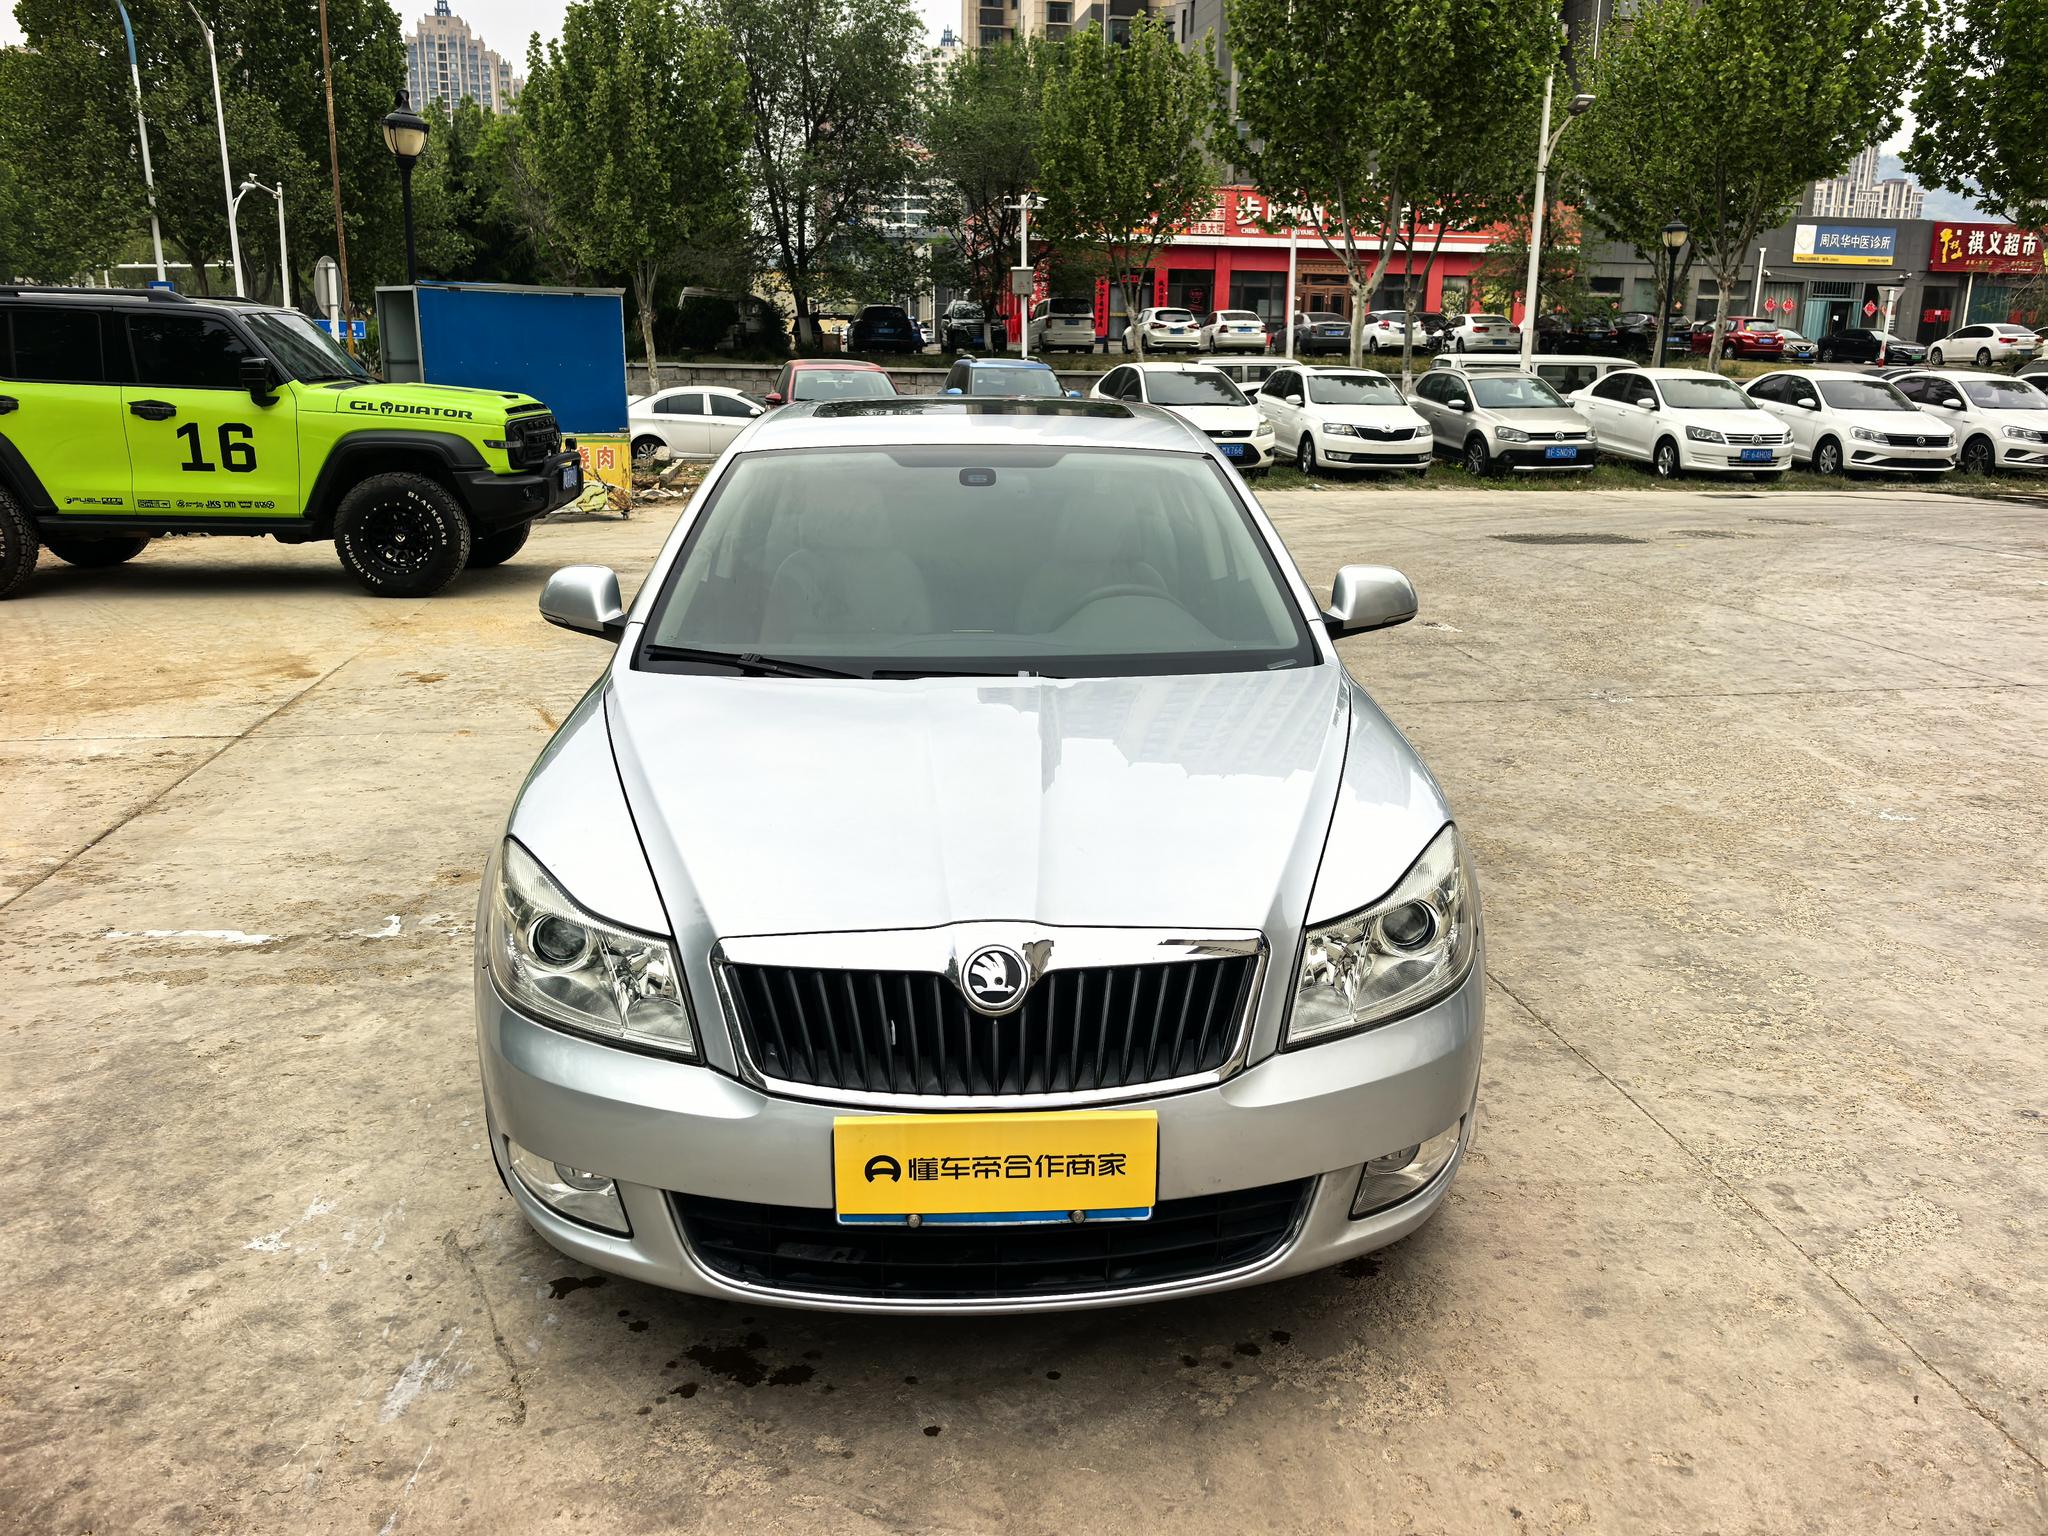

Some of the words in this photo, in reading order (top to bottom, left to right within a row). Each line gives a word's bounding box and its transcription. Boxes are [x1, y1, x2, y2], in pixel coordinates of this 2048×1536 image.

[1819, 233, 1891, 250] 周风华中医诊所
[1967, 230, 2038, 256] 祺义超市
[176, 422, 257, 473] 16
[908, 1153, 1127, 1182] 懂车帝合作商家
